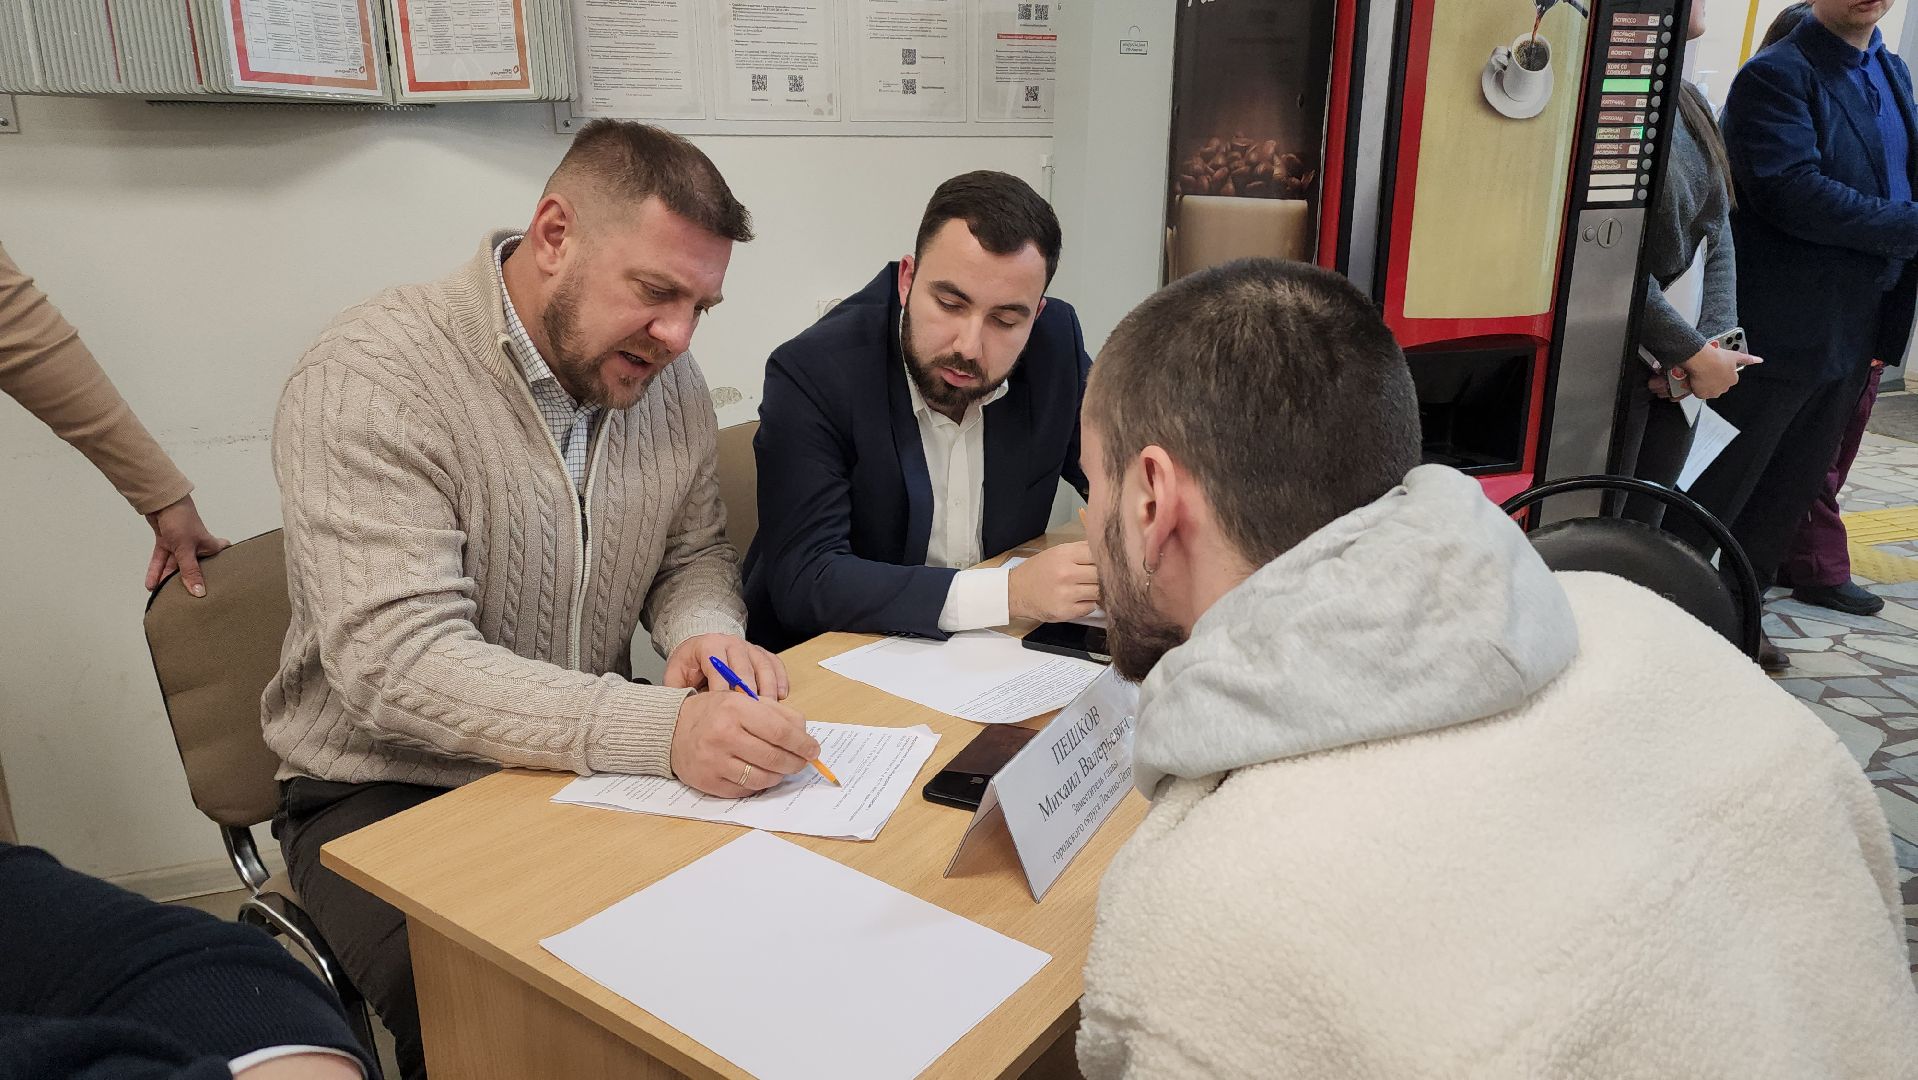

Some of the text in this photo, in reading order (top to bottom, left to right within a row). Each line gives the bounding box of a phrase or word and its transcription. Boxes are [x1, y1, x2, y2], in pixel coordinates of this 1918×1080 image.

[1051, 705, 1101, 766] ПЕШКОВ
[1038, 716, 1131, 823] Михаил Валерьевич
[1071, 760, 1120, 816] Заместитель главы
[1052, 822, 1085, 864] городского
[1083, 801, 1103, 826] округа
